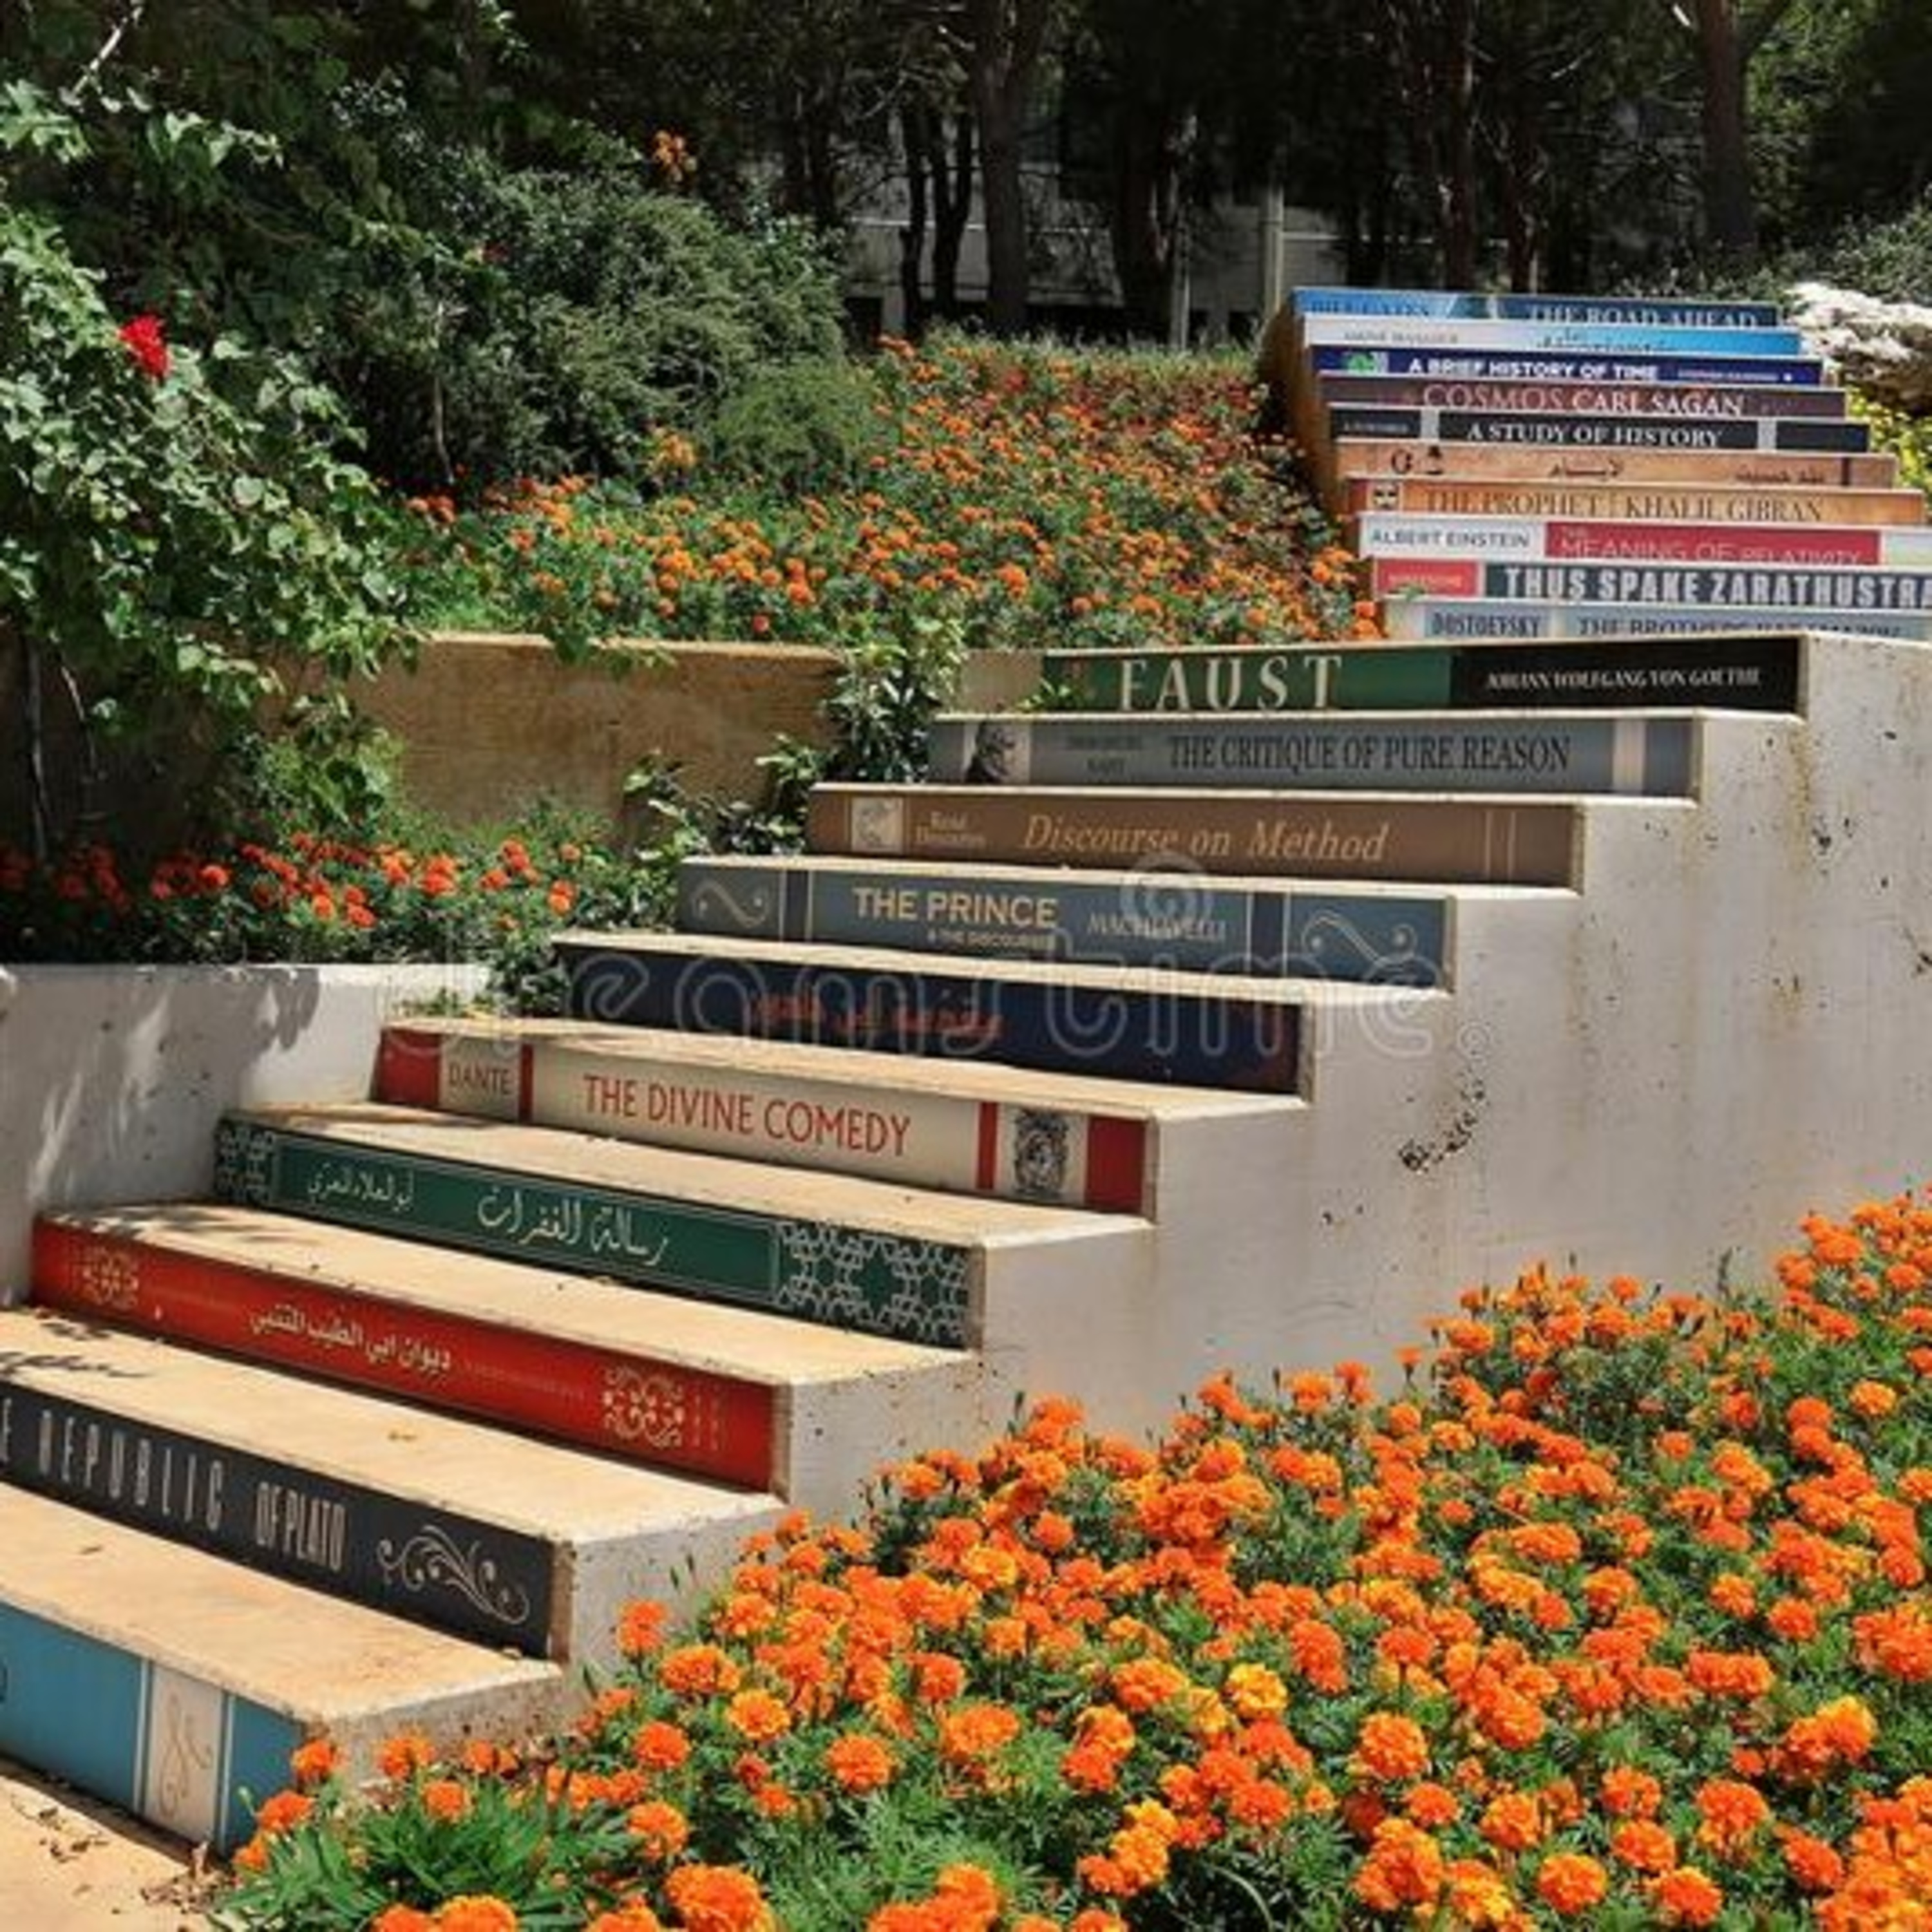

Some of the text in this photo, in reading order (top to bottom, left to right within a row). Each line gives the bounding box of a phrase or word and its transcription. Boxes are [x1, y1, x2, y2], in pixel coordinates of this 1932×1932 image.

[1529, 304, 1578, 323] THE
[1408, 358, 1423, 374] A
[1427, 359, 1484, 374] BRIEF
[1490, 361, 1573, 378] HISTORY
[1579, 363, 1609, 379] OF
[1613, 365, 1658, 381] TIME
[1424, 384, 1745, 417] COSMOS CARL SAGAN
[1467, 423, 1722, 448] A STUDY OF HISTORY
[1490, 491, 1600, 516] PROPHET
[1625, 495, 1715, 519] KHALIL
[1727, 496, 1823, 522] GIBRAN
[1371, 529, 1531, 549] ALBERT EINSTEIN
[1506, 567, 1932, 609] THUS SPAKE ZARATHUSTRA
[1119, 654, 1342, 711] FAUST
[1168, 734, 1217, 768] THE
[1222, 735, 1335, 775] CRITIQUE
[1343, 736, 1379, 771] OF
[1383, 737, 1452, 771] PURE
[1463, 735, 1571, 772] REASON
[1023, 814, 1390, 863] Discourse on Method
[851, 886, 1059, 929] THE PRINCE
[449, 1063, 510, 1096] DANTE
[583, 1072, 913, 1157] THE DIVINE COMEDY
[38, 1408, 226, 1532] REPUBLIC
[256, 1481, 281, 1548] OF
[284, 1493, 346, 1574] PLATO
